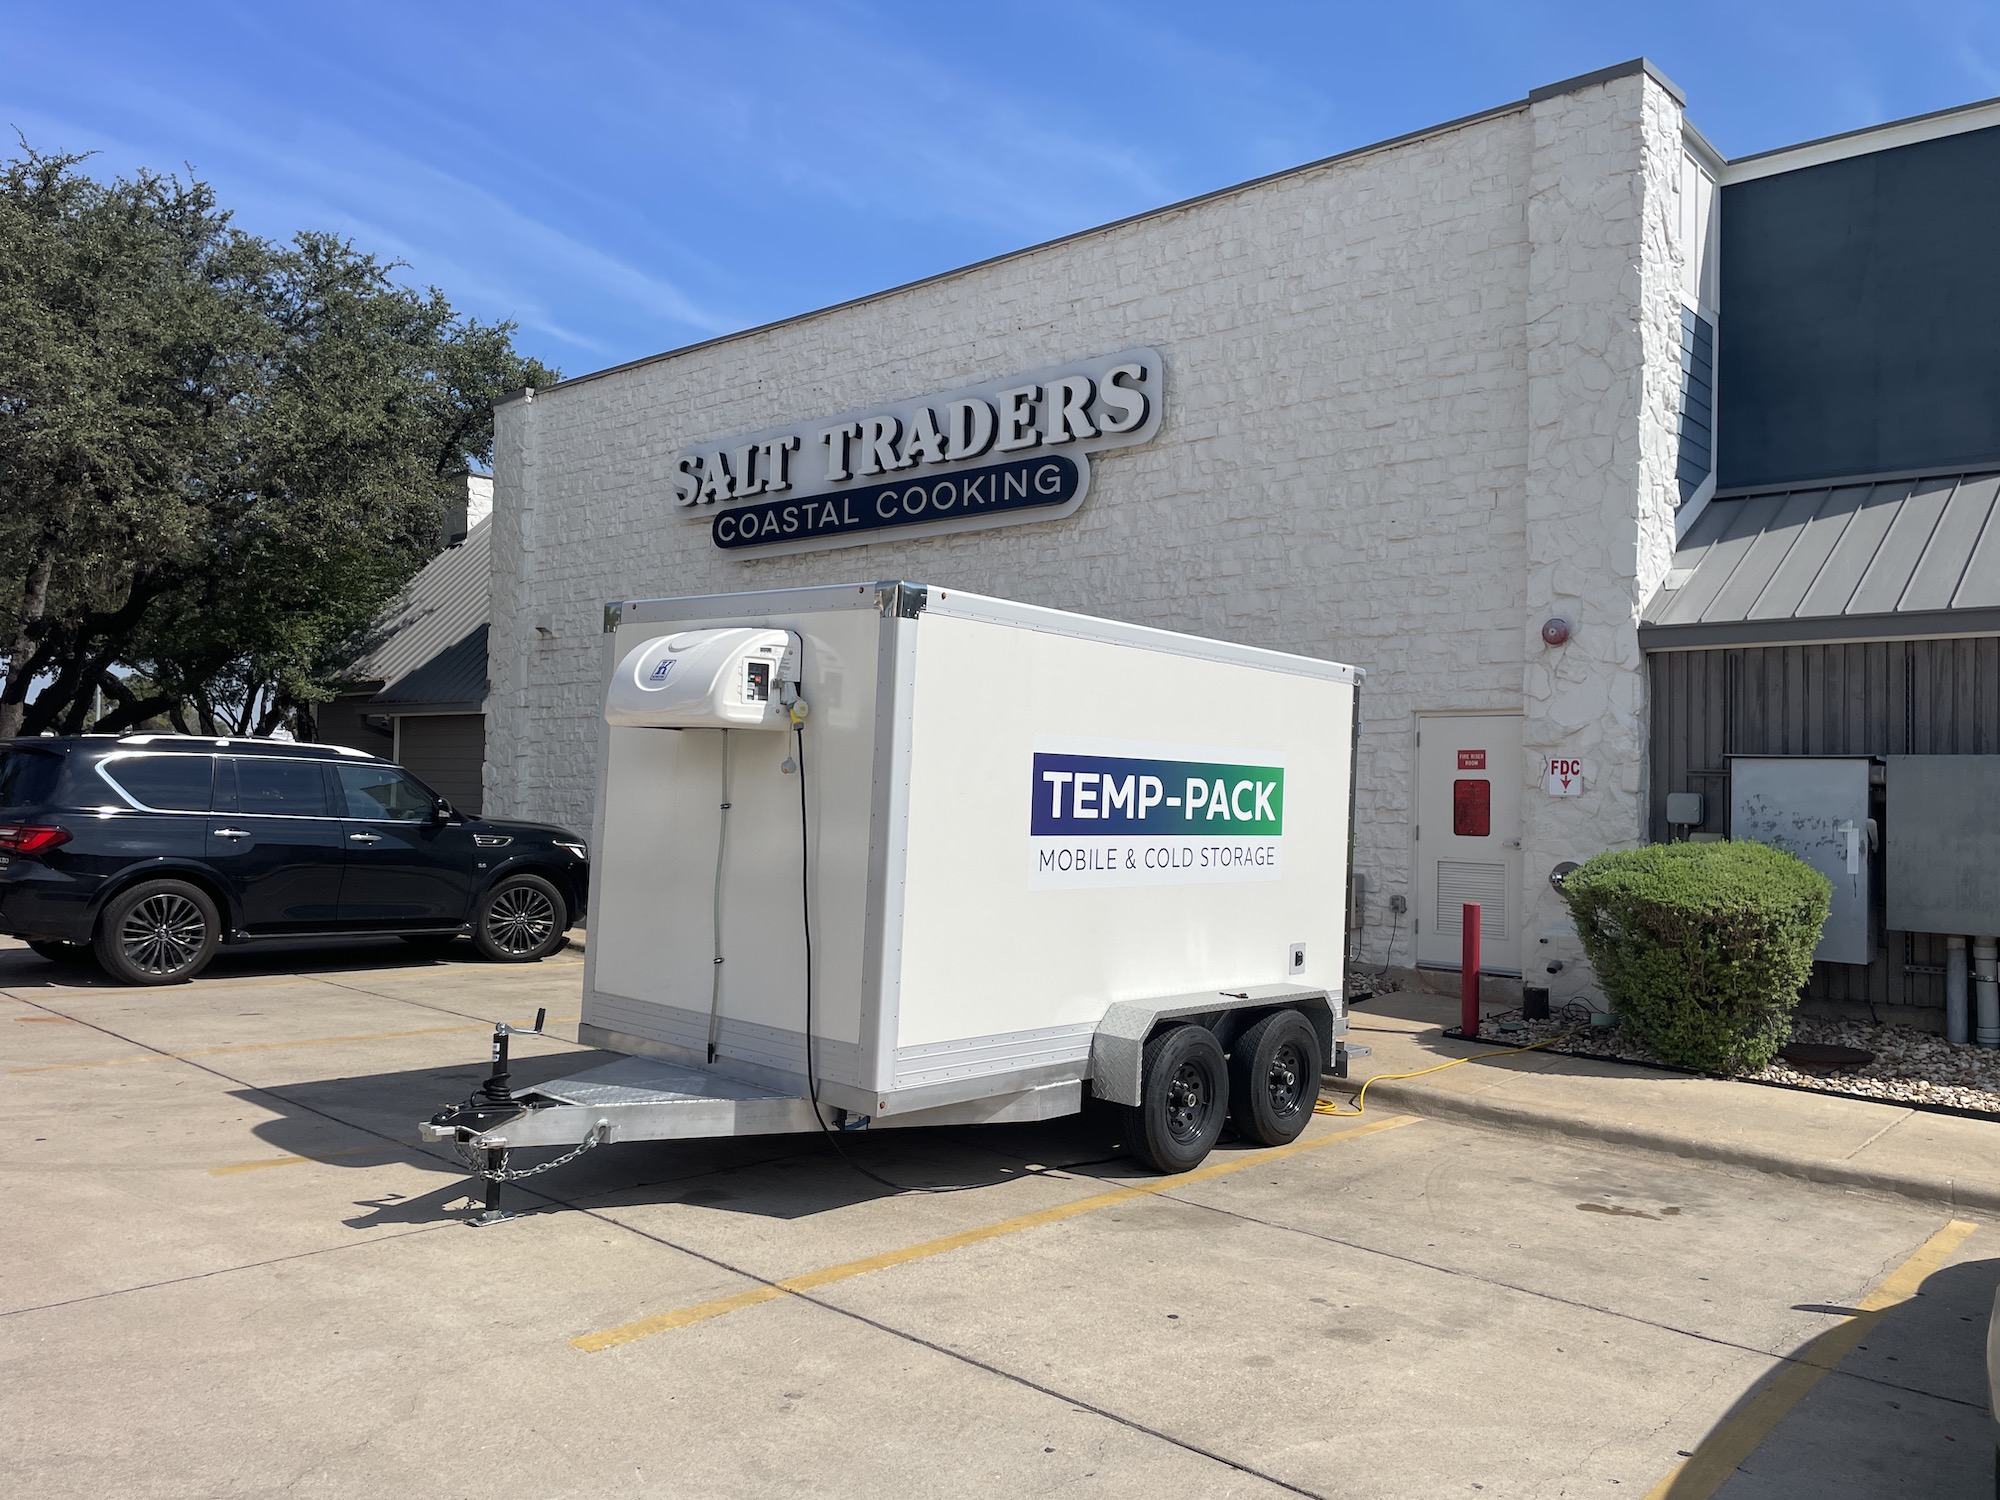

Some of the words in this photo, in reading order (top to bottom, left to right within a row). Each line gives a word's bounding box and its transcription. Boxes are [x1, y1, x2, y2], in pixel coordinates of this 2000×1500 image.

[672, 434, 800, 508] SALT
[819, 363, 1149, 482] TRADERS
[717, 502, 860, 542] COASTAL
[876, 464, 1062, 519] COOKING
[1551, 760, 1580, 775] FDC
[1043, 771, 1277, 821] TEMP-PACK
[1039, 848, 1117, 872] MOBILE
[1125, 848, 1136, 870] &
[1145, 847, 1194, 869] COLD
[1200, 846, 1275, 868] STORAGE
